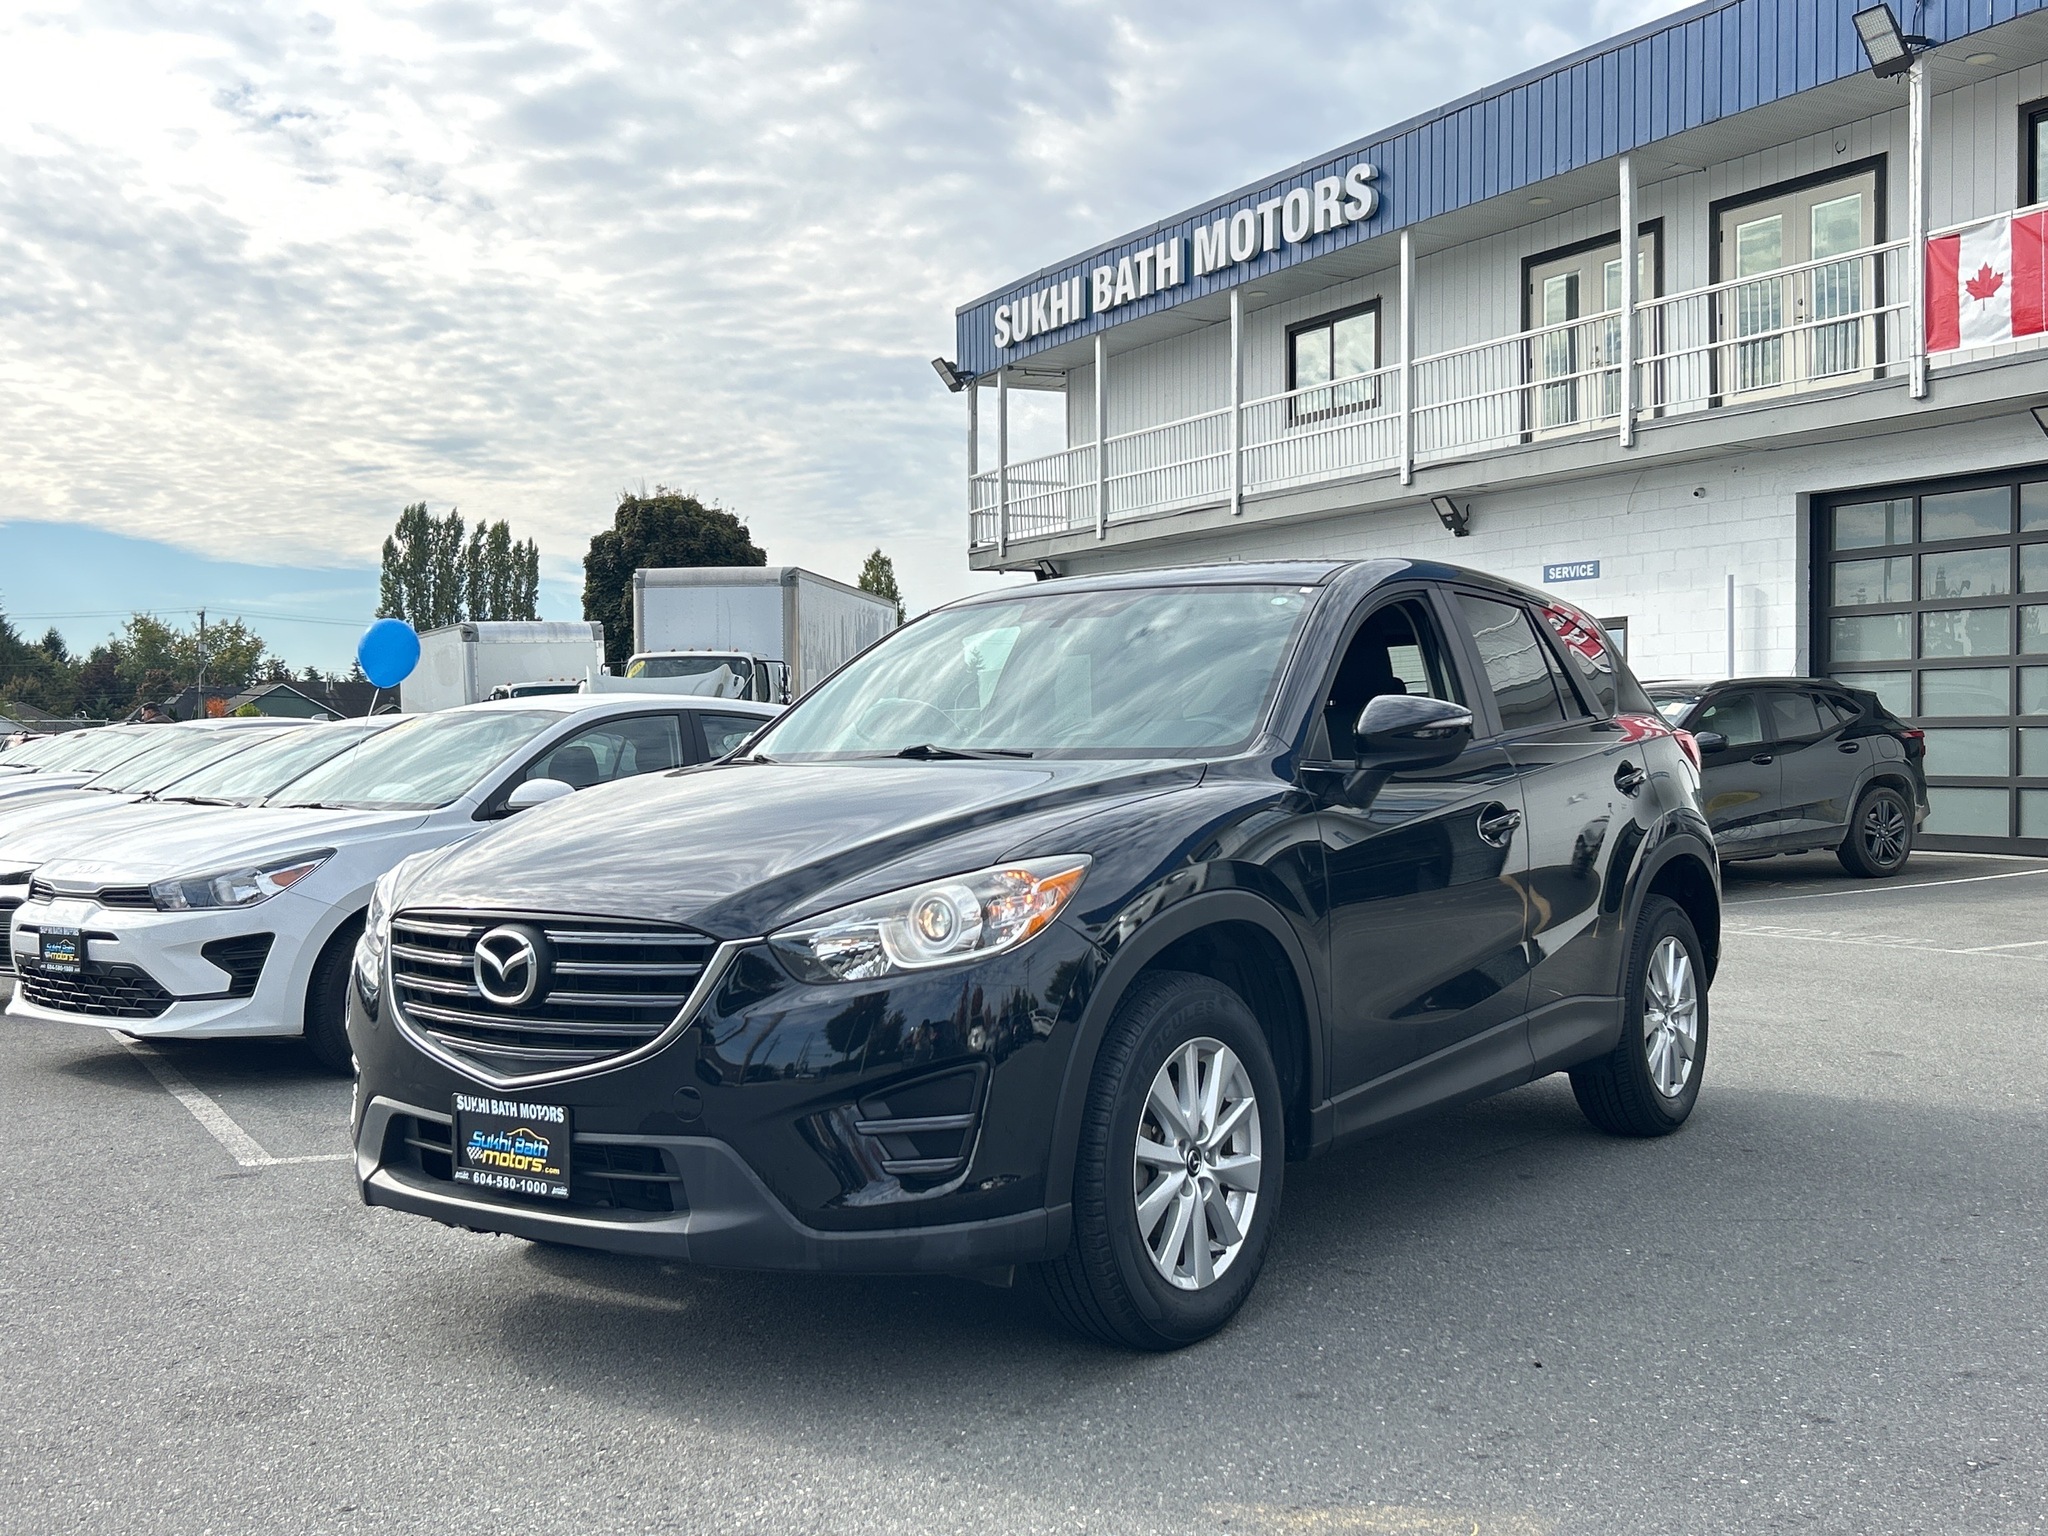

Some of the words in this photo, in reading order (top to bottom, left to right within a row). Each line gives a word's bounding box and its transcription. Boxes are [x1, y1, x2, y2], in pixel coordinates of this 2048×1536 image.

[994, 276, 1087, 349] SUKHI
[1092, 237, 1187, 314] BATH
[1194, 163, 1379, 276] MOTORS
[1549, 564, 1594, 580] SERVICE
[456, 1095, 490, 1114] SUKHI
[491, 1099, 518, 1117] BATH
[520, 1103, 565, 1123] MOTORS
[468, 1130, 512, 1152] Sukhi
[515, 1137, 549, 1157] Bath
[473, 1171, 547, 1195] 604-580-1000
